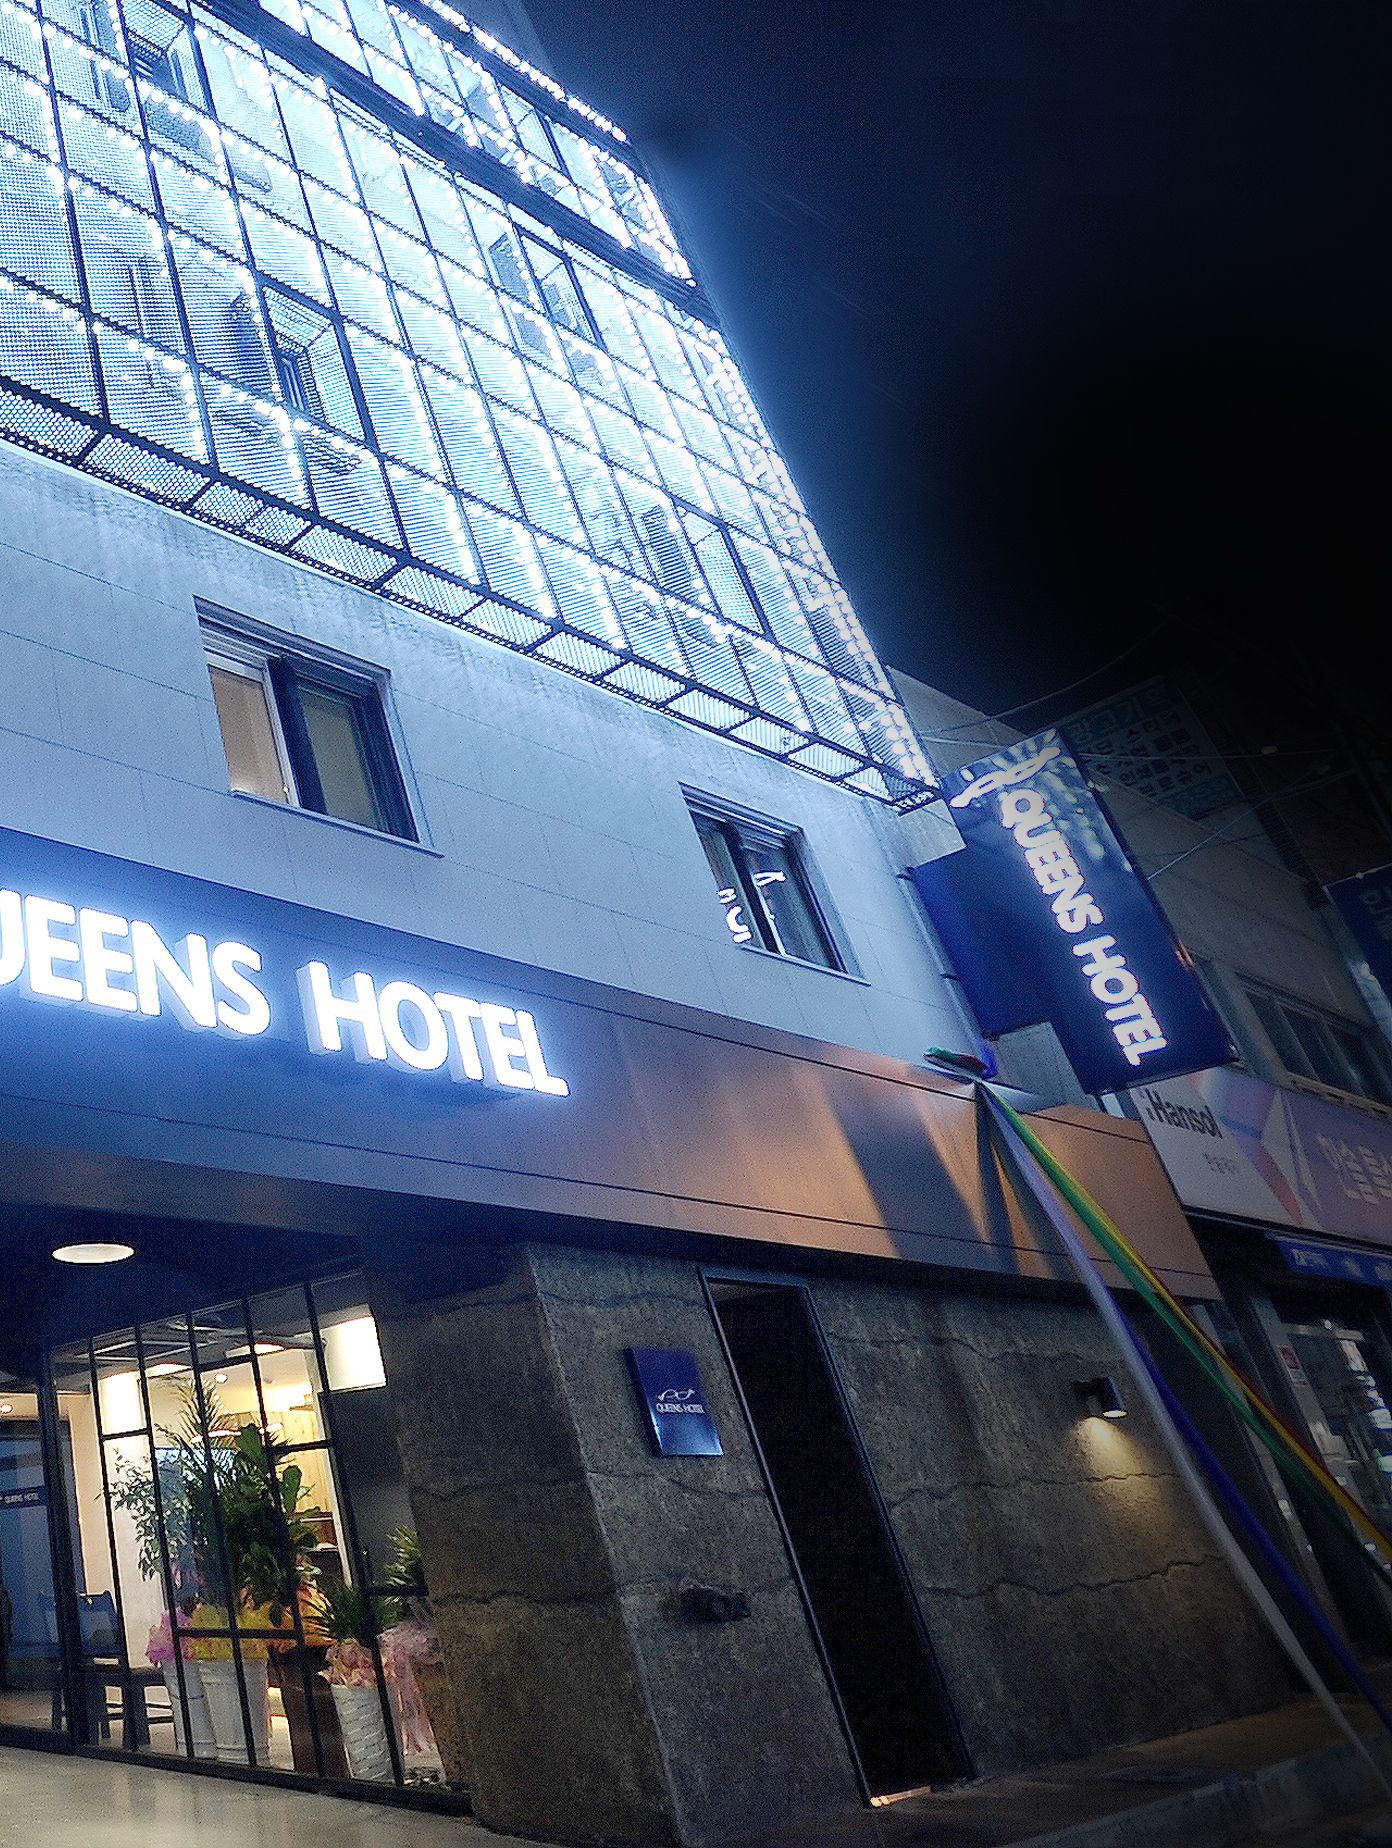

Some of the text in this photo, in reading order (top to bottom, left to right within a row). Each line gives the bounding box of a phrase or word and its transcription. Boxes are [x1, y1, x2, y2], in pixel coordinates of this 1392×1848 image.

[999, 790, 1168, 1067] QUEENS HOTEL
[300, 961, 570, 1098] HOTEL
[1145, 1088, 1223, 1139] Hansol
